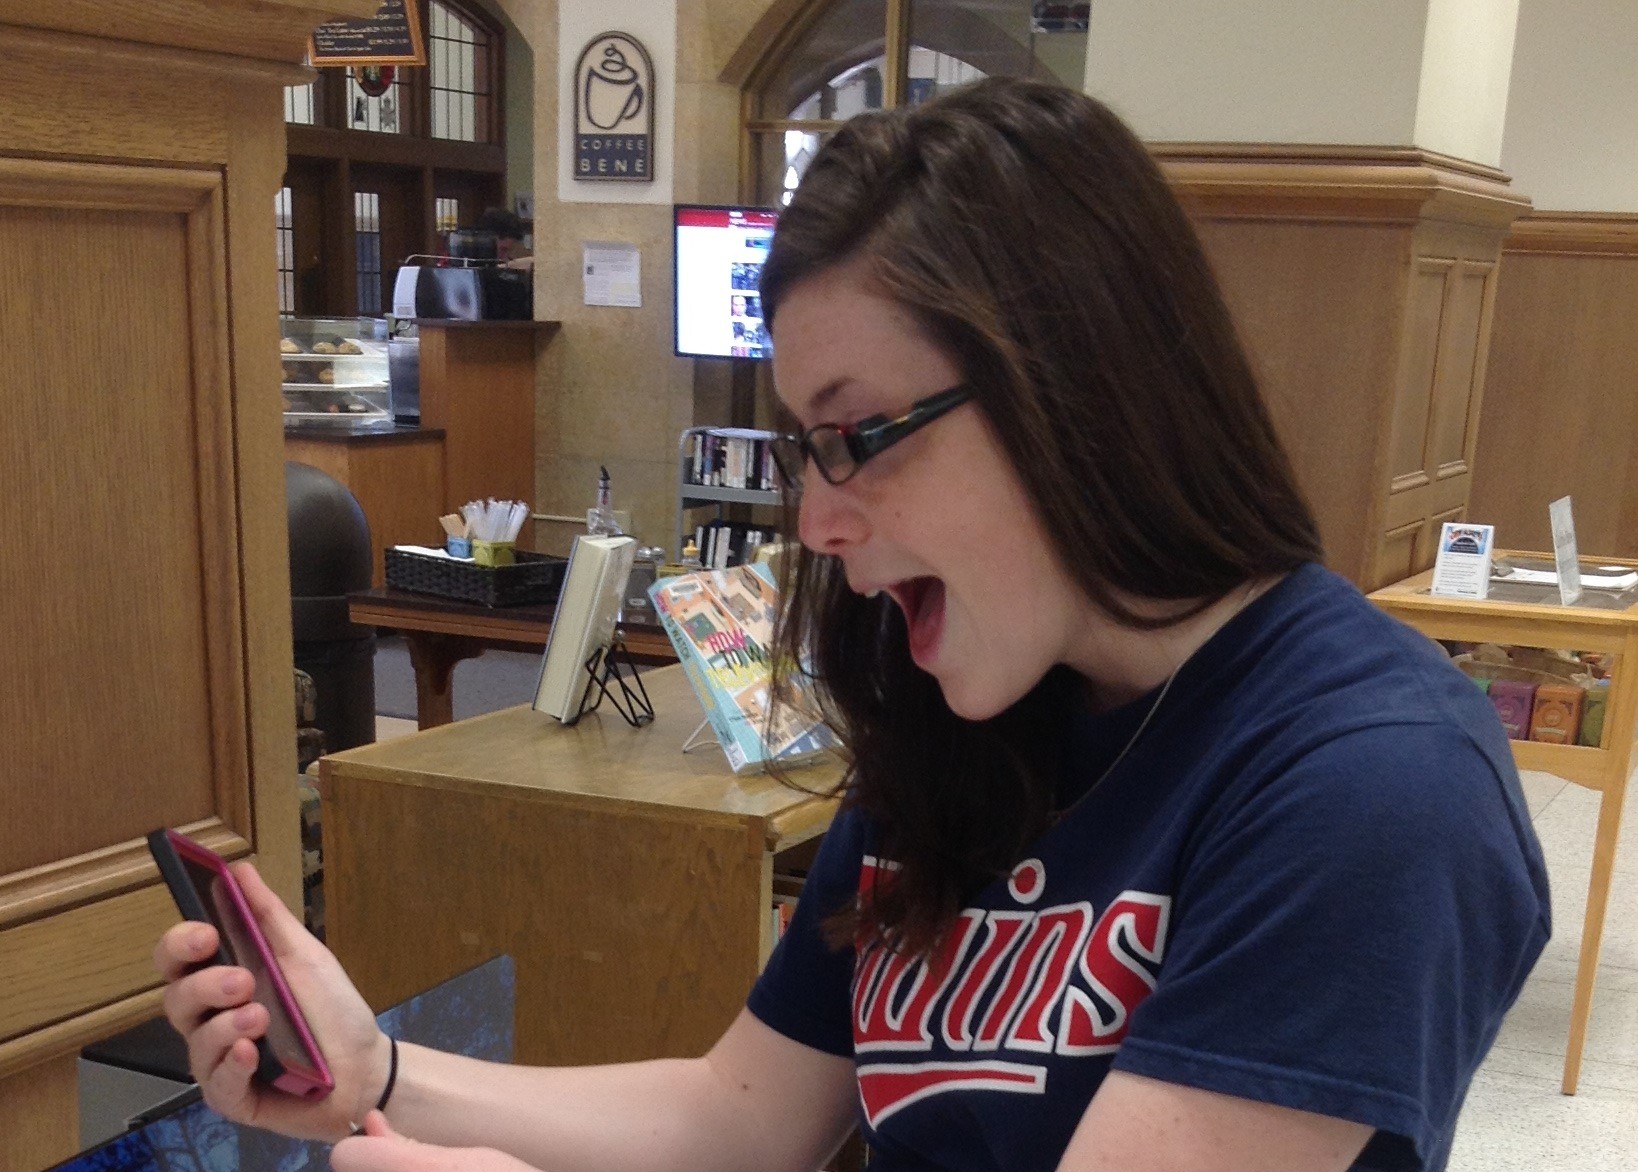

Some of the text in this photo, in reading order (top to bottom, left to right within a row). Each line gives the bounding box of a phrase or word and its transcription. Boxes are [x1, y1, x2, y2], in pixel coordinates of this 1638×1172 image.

[580, 139, 645, 151] COFFEE
[580, 158, 645, 173] BENE
[706, 629, 747, 654] HOW
